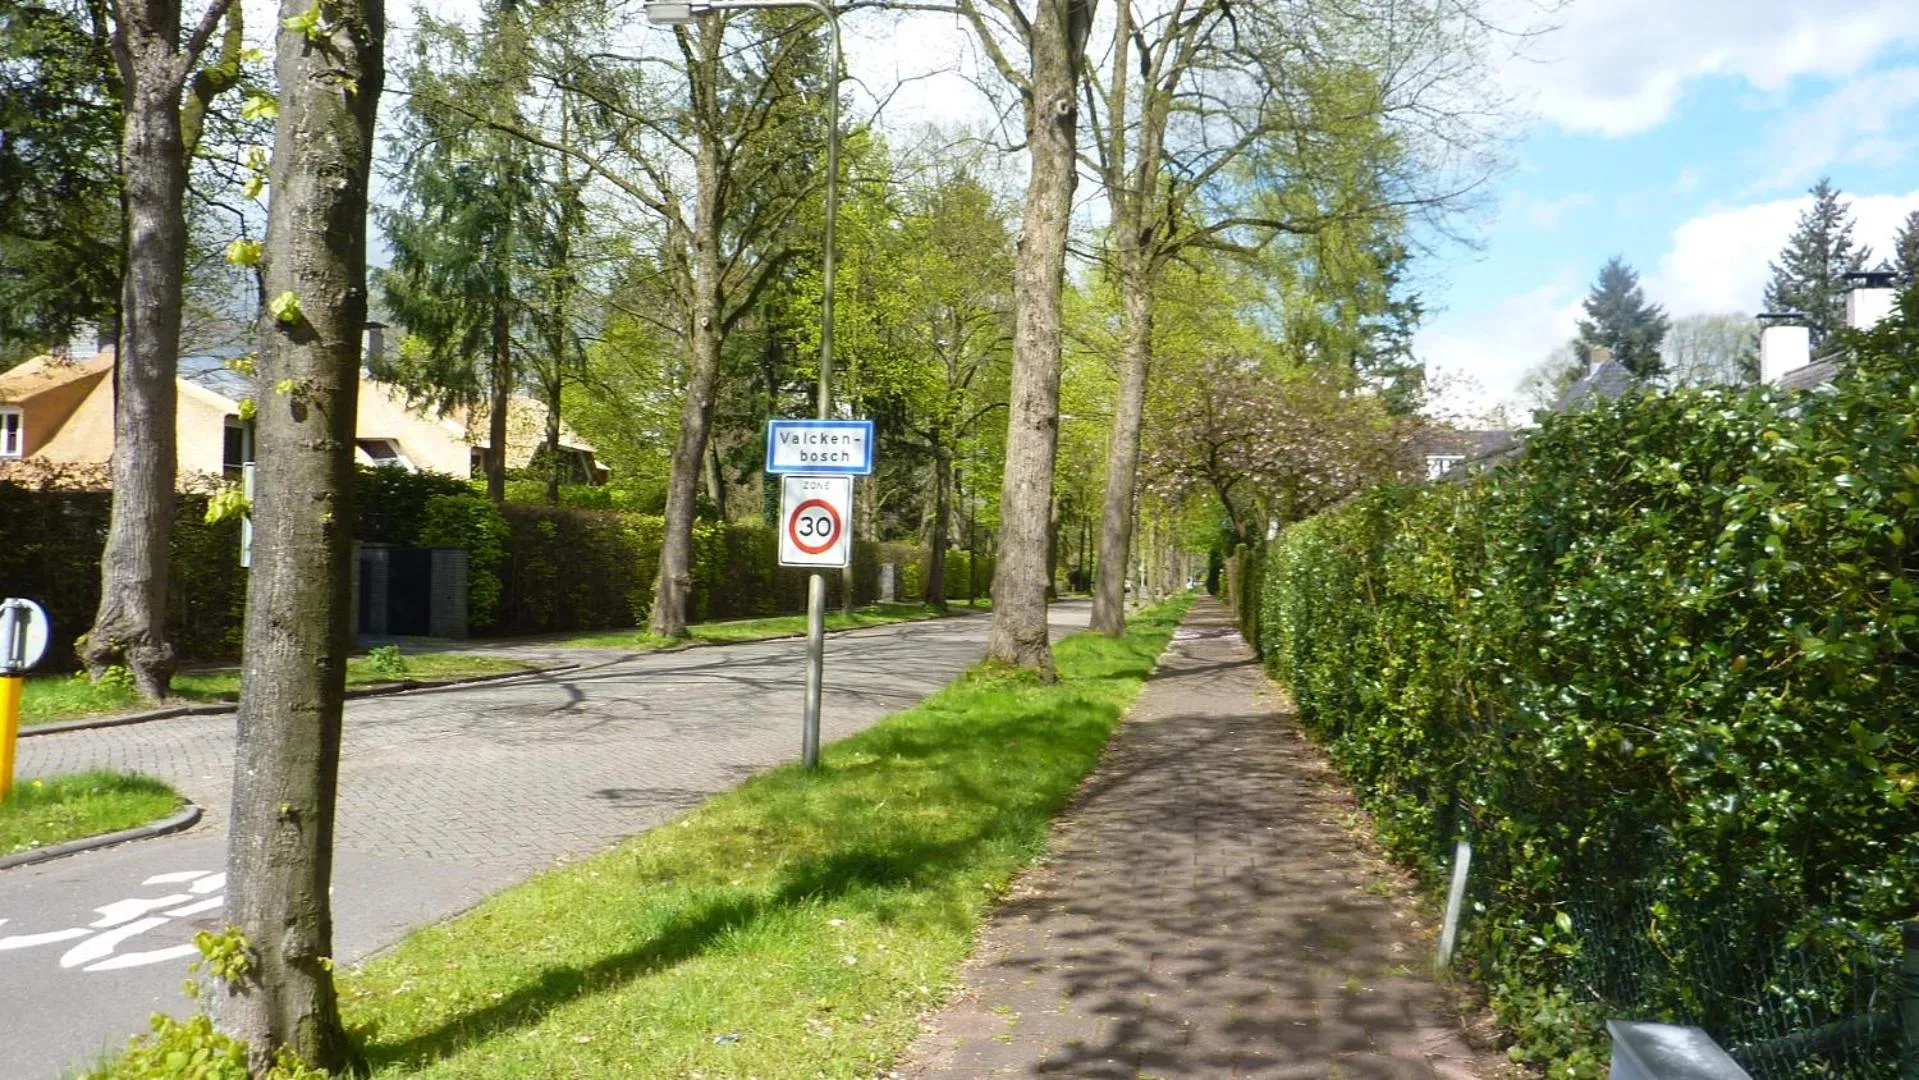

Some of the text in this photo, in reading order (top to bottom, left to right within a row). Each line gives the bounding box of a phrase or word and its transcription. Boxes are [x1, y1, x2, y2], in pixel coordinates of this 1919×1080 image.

[779, 431, 861, 445] Valcken-
[800, 450, 850, 462] bosch
[802, 481, 831, 490] ZONE
[799, 516, 832, 537] 30
